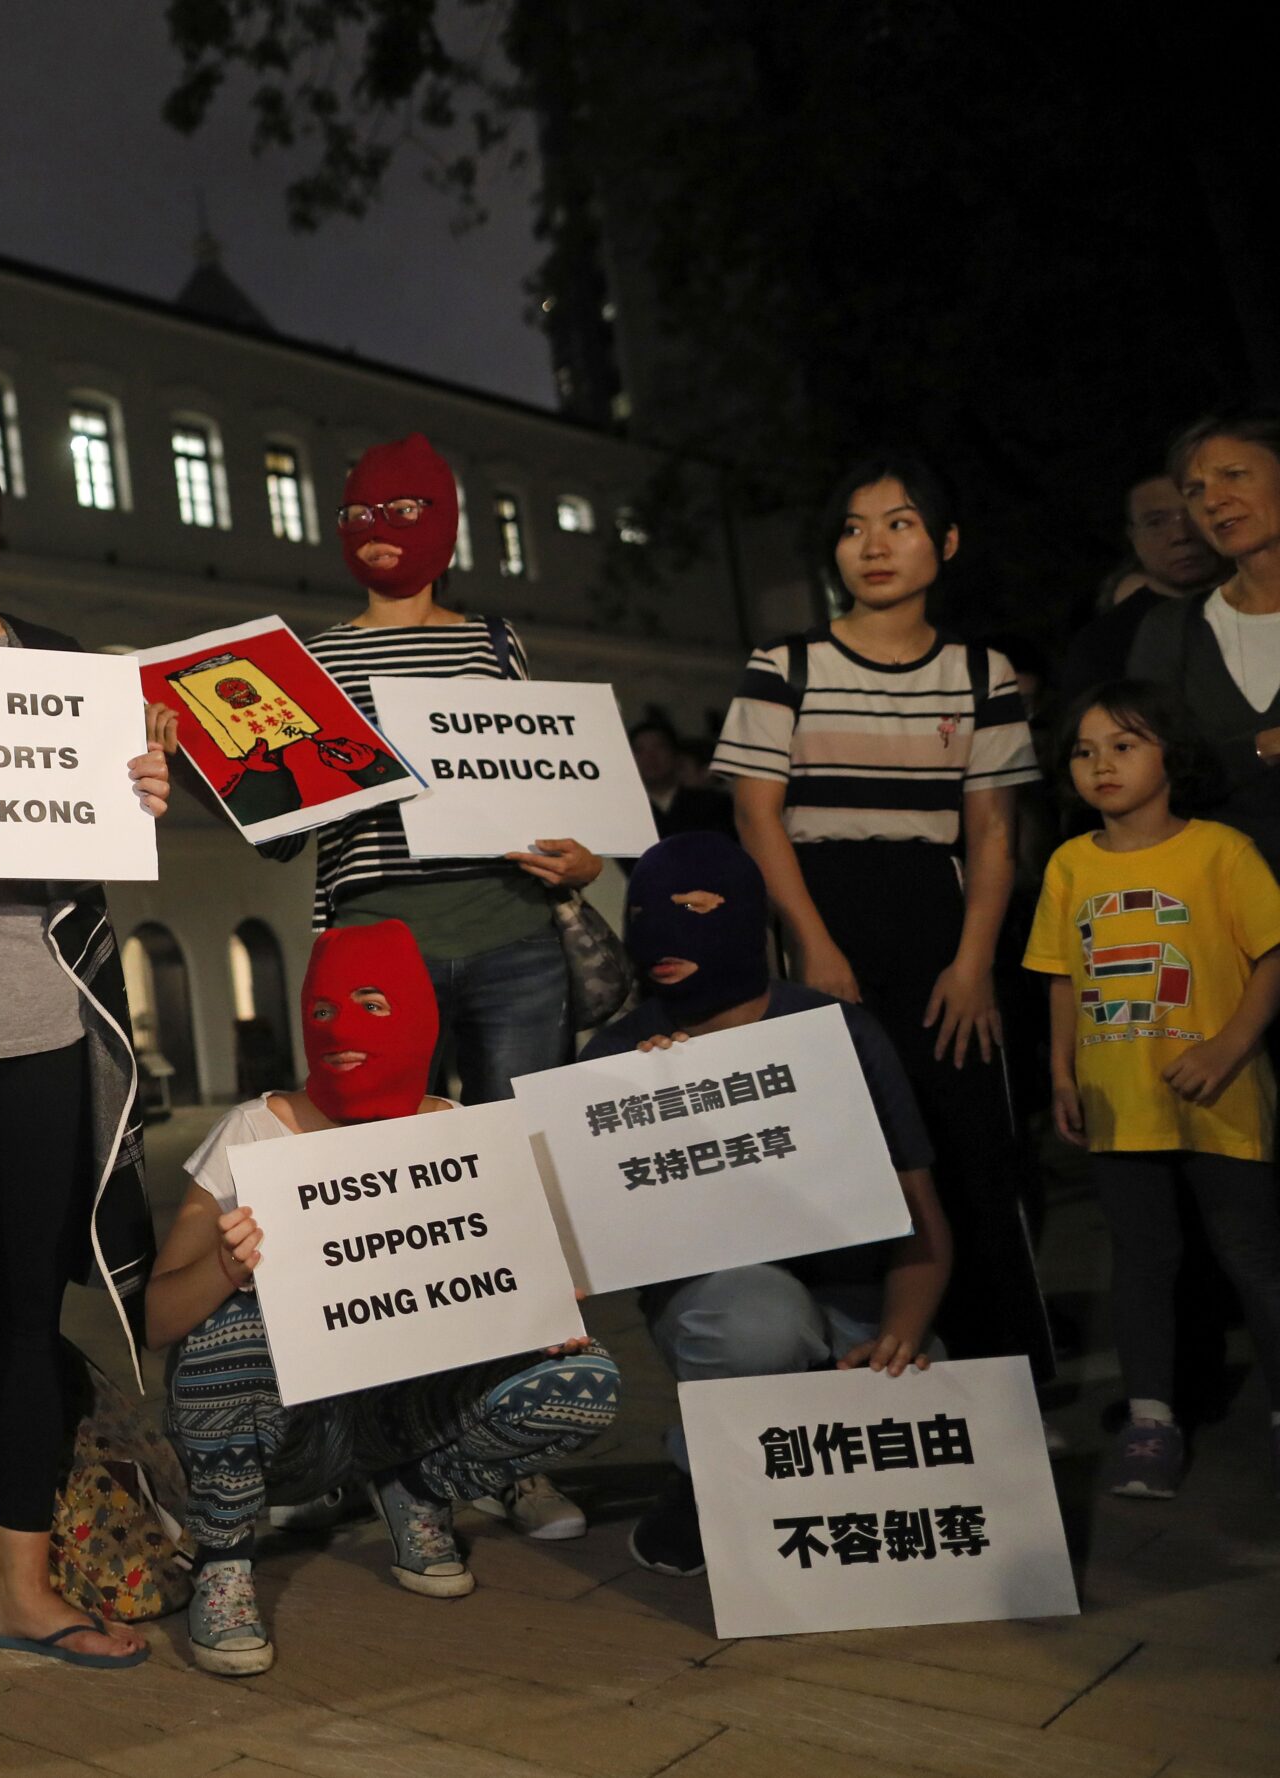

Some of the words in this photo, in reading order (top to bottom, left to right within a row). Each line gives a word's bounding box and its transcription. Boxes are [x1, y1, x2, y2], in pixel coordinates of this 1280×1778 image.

[7, 692, 84, 717] RIOT
[429, 712, 575, 735] SUPPORT
[431, 758, 600, 780] BADIUCAO
[0, 799, 96, 825] KONG
[585, 1063, 797, 1137] 捍衛言論自由
[297, 1168, 398, 1210] PUSSY
[408, 1153, 480, 1189] RIOT
[322, 1212, 488, 1267] SUPPORTS
[322, 1288, 419, 1331] HONG
[425, 1267, 518, 1310] KONG
[758, 1413, 975, 1480] 創作自由
[773, 1504, 990, 1569] 不容剝奪
